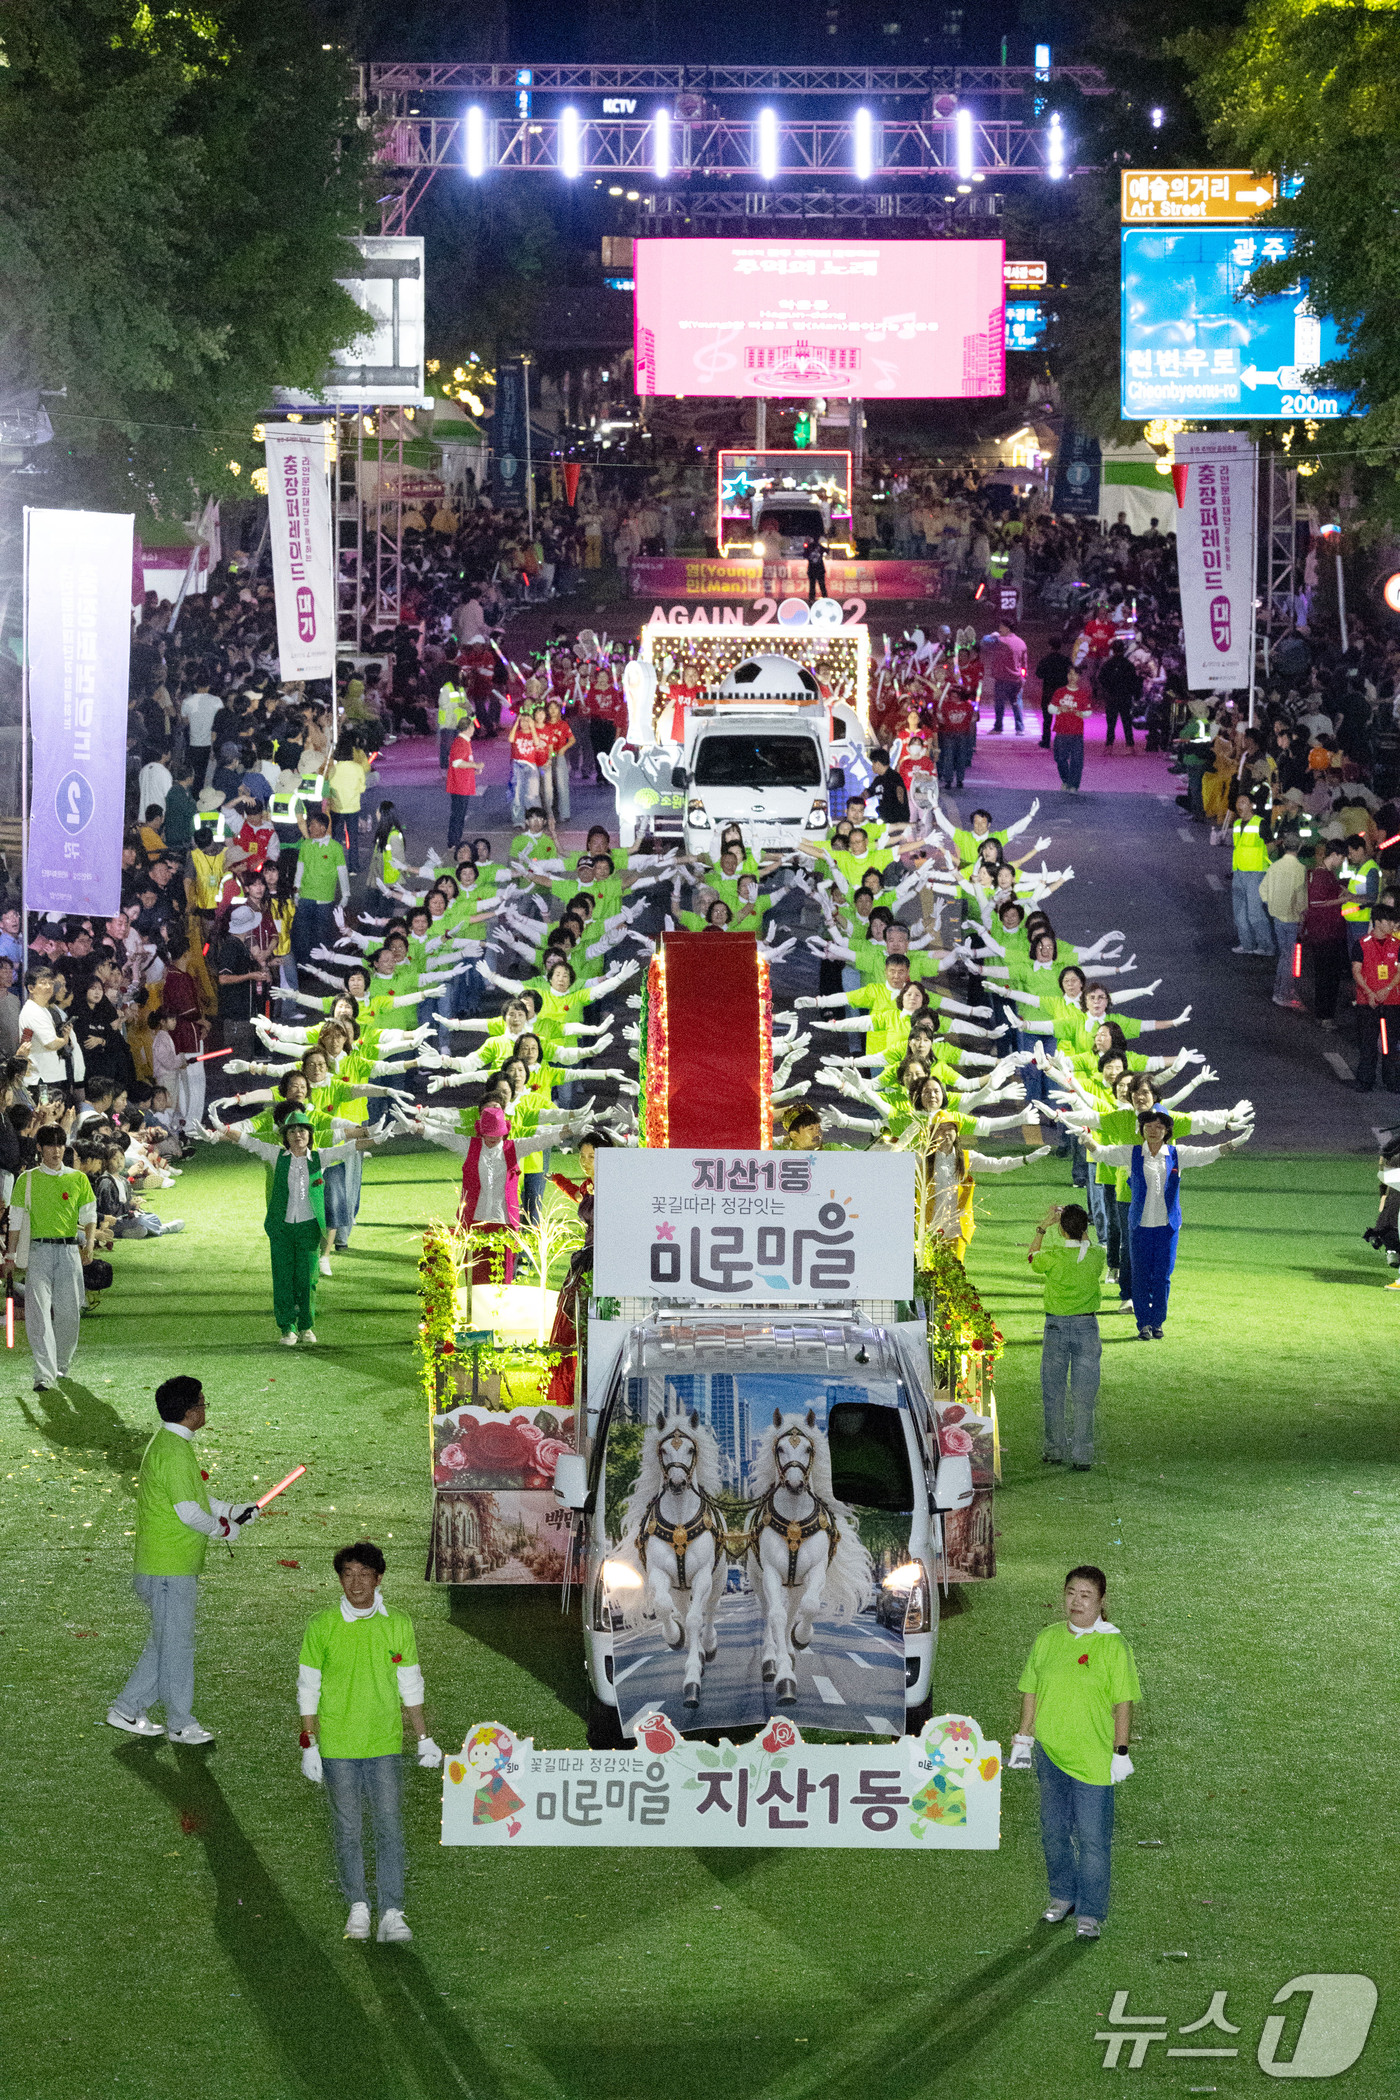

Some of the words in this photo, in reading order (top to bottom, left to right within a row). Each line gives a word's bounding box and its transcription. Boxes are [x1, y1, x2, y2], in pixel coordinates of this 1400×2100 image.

[603, 98, 637, 113] KCTV
[1129, 176, 1230, 201] 예술의거리
[1130, 201, 1155, 216] Art
[1160, 201, 1207, 216] Street
[820, 259, 878, 276] 노래
[1127, 349, 1238, 377] 천변우로
[1281, 395, 1338, 413] 200m
[283, 455, 306, 581] 충장퍼레이드
[1199, 464, 1224, 590] 충장퍼레이드
[297, 594, 314, 636] 대기
[649, 605, 744, 625] AGAIN
[1001, 598, 1016, 609] 23
[1212, 603, 1230, 645] 대기
[693, 1158, 812, 1193] 지산1동
[651, 1195, 717, 1215] 꽃길따라
[721, 1196, 786, 1215] 정감잇는
[650, 1202, 855, 1293] 미로마을
[531, 1757, 584, 1773] 꽃길따라
[590, 1757, 644, 1773] 정감잇는
[918, 1759, 933, 1771] 미로
[536, 1761, 670, 1827] 미로마을
[696, 1768, 910, 1832] 지산1동
